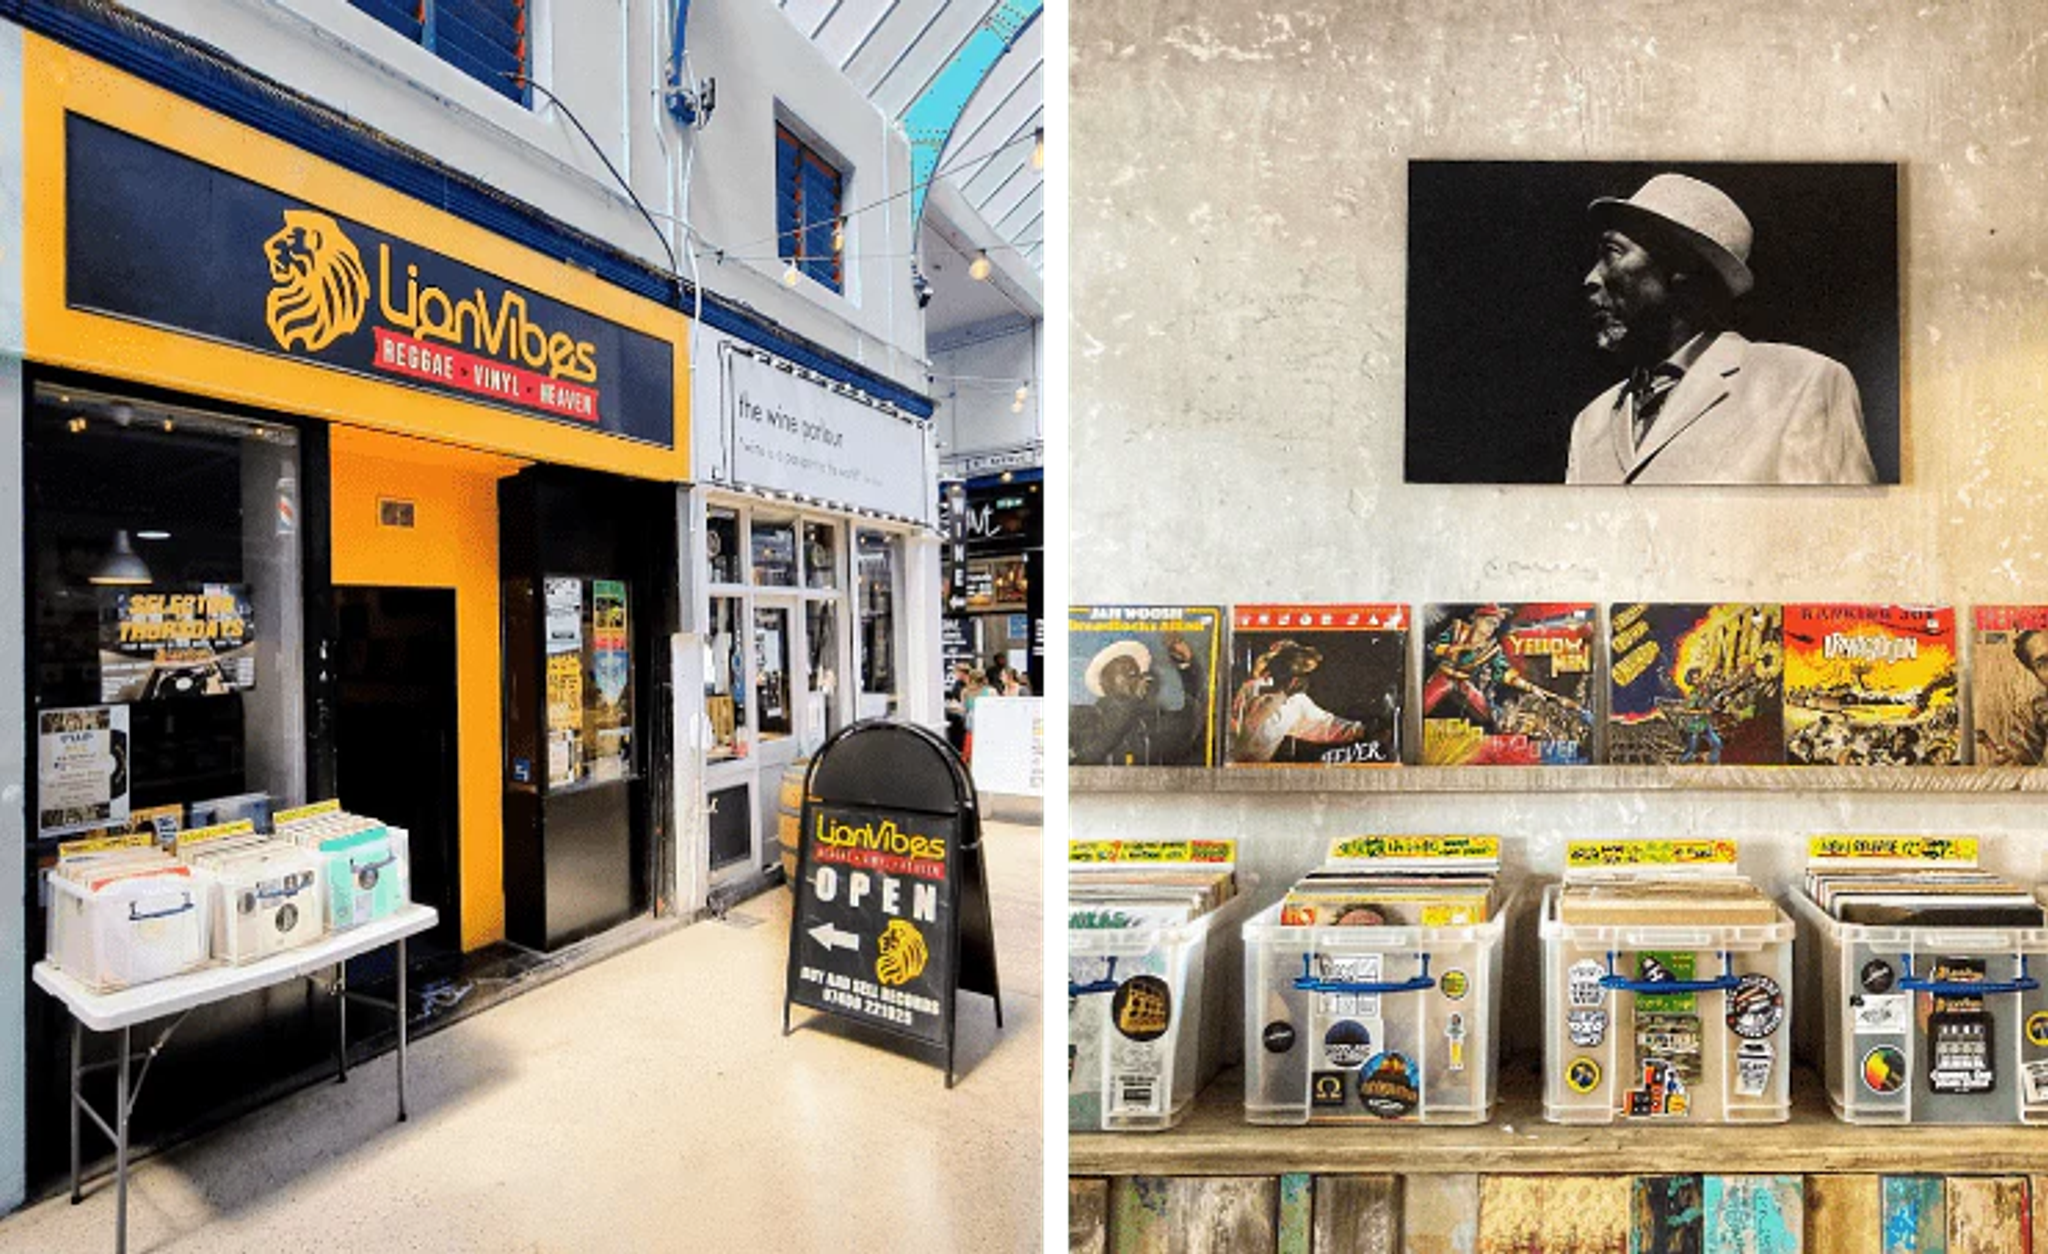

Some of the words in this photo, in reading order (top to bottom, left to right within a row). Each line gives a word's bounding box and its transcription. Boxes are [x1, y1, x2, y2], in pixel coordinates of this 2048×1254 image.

[379, 242, 598, 383] LionVibes
[382, 339, 454, 379] REGGAE
[473, 364, 519, 397] VINYL
[539, 382, 592, 415] HEAVEN
[738, 391, 762, 423] the
[767, 404, 798, 434] wine
[801, 416, 843, 449] parlour
[950, 496, 966, 588] WINE
[1508, 634, 1583, 657] YELLOW
[1321, 741, 1386, 764] FEVER
[815, 811, 946, 861] LionVibes
[815, 866, 937, 924] OPEN
[800, 966, 826, 985] BUY
[826, 971, 851, 991] AND
[852, 978, 879, 999] SELL
[880, 986, 940, 1016] RECORDS
